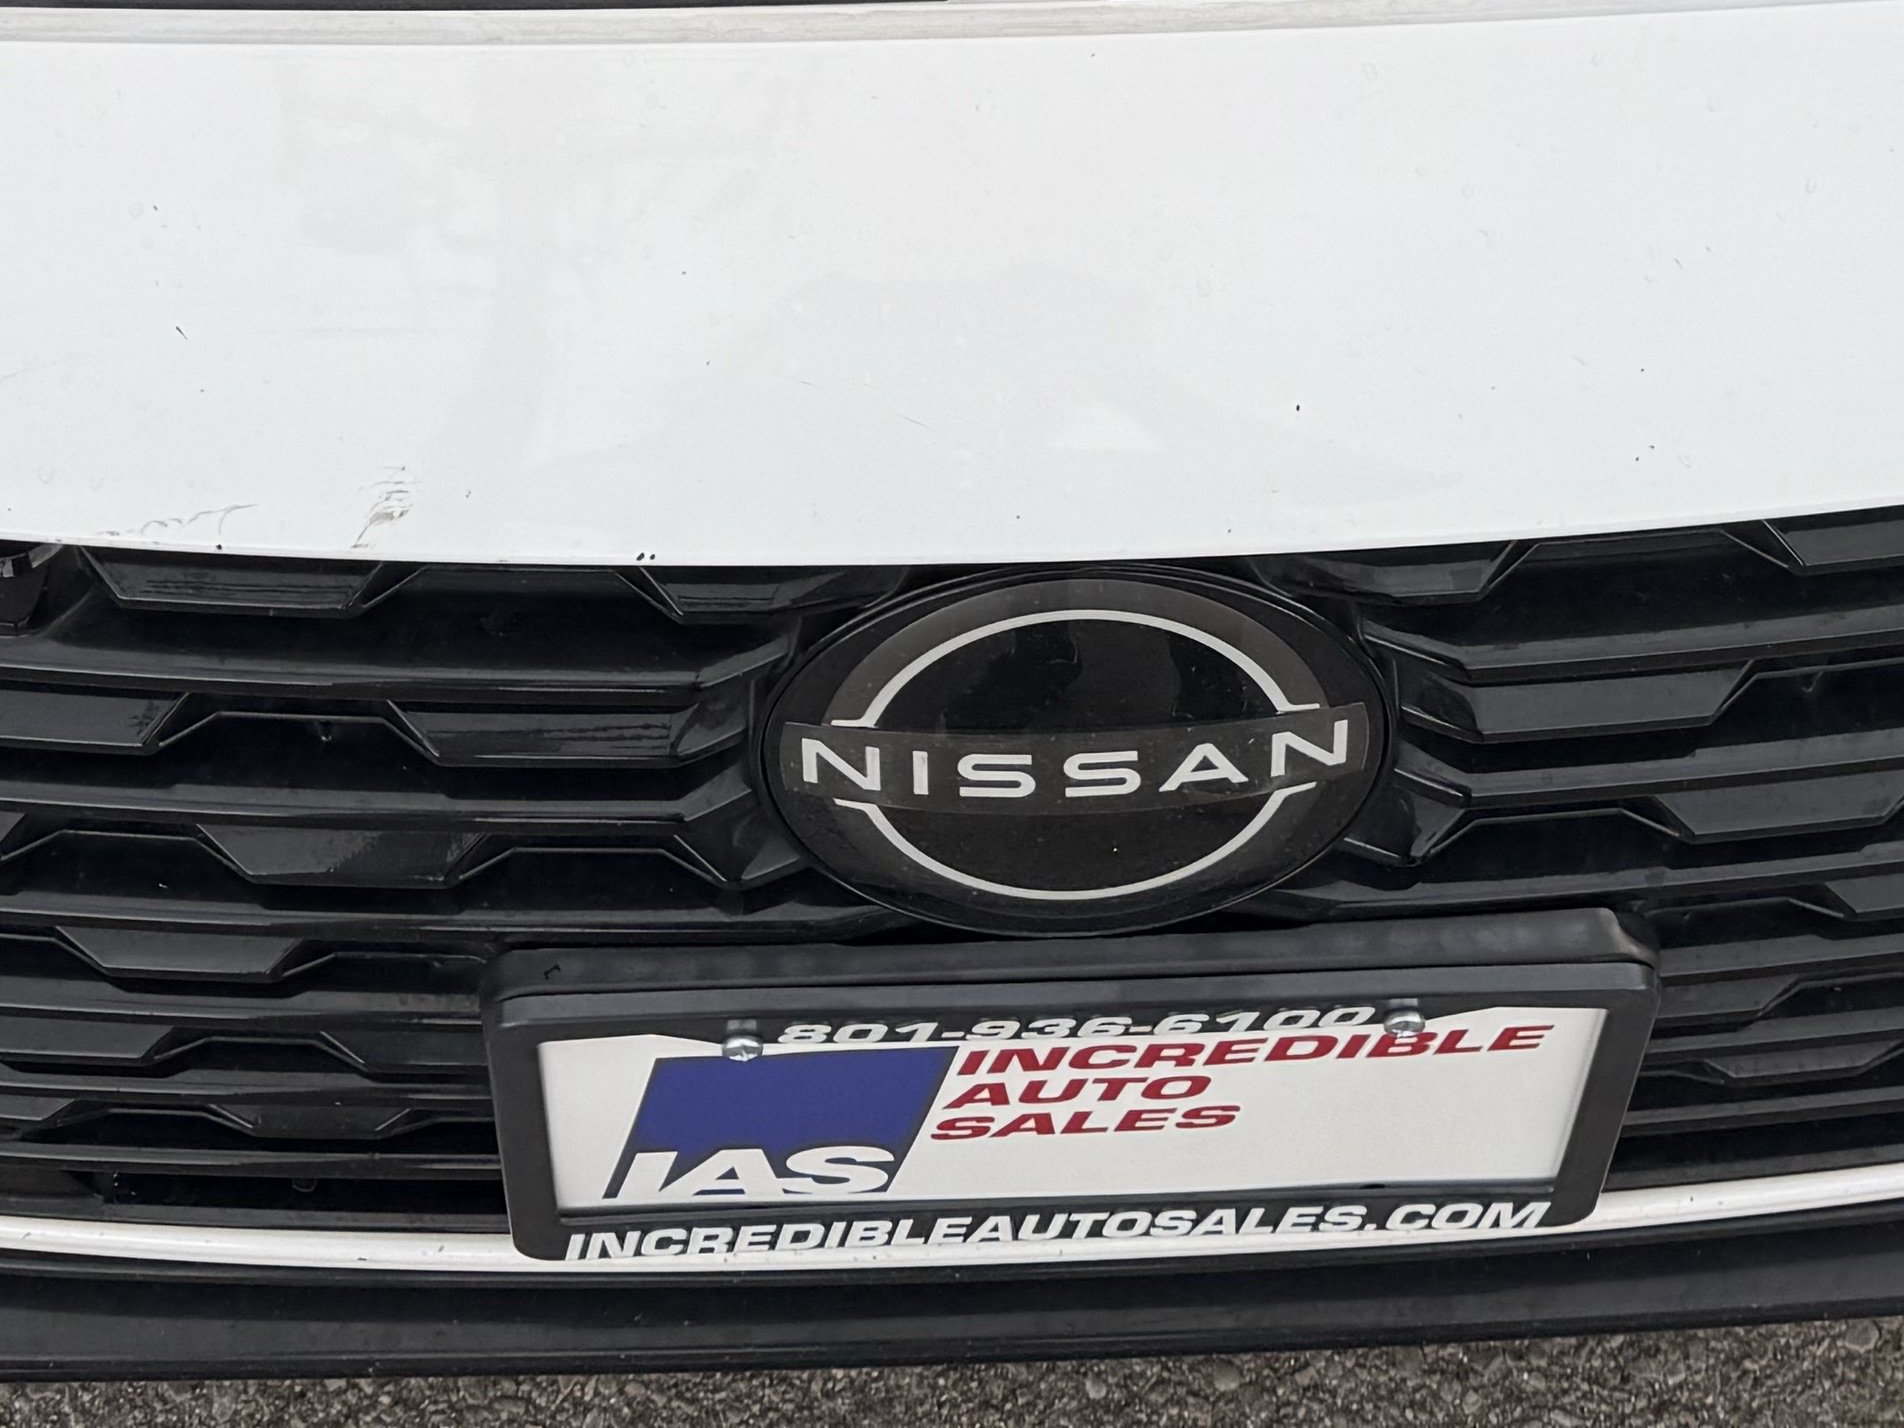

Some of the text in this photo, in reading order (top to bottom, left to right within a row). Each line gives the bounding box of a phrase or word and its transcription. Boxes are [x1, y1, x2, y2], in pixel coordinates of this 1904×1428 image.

[801, 719, 1349, 798] NISSAN
[776, 1005, 1377, 1045] 801-936-6100
[957, 1024, 1555, 1076] INCREDIBLE
[941, 1075, 1213, 1110] AUTO
[929, 1104, 1241, 1141] SALES
[617, 1146, 895, 1199] IAS
[565, 1201, 1551, 1261] INCREDIBLEAUTOSALES.COM
